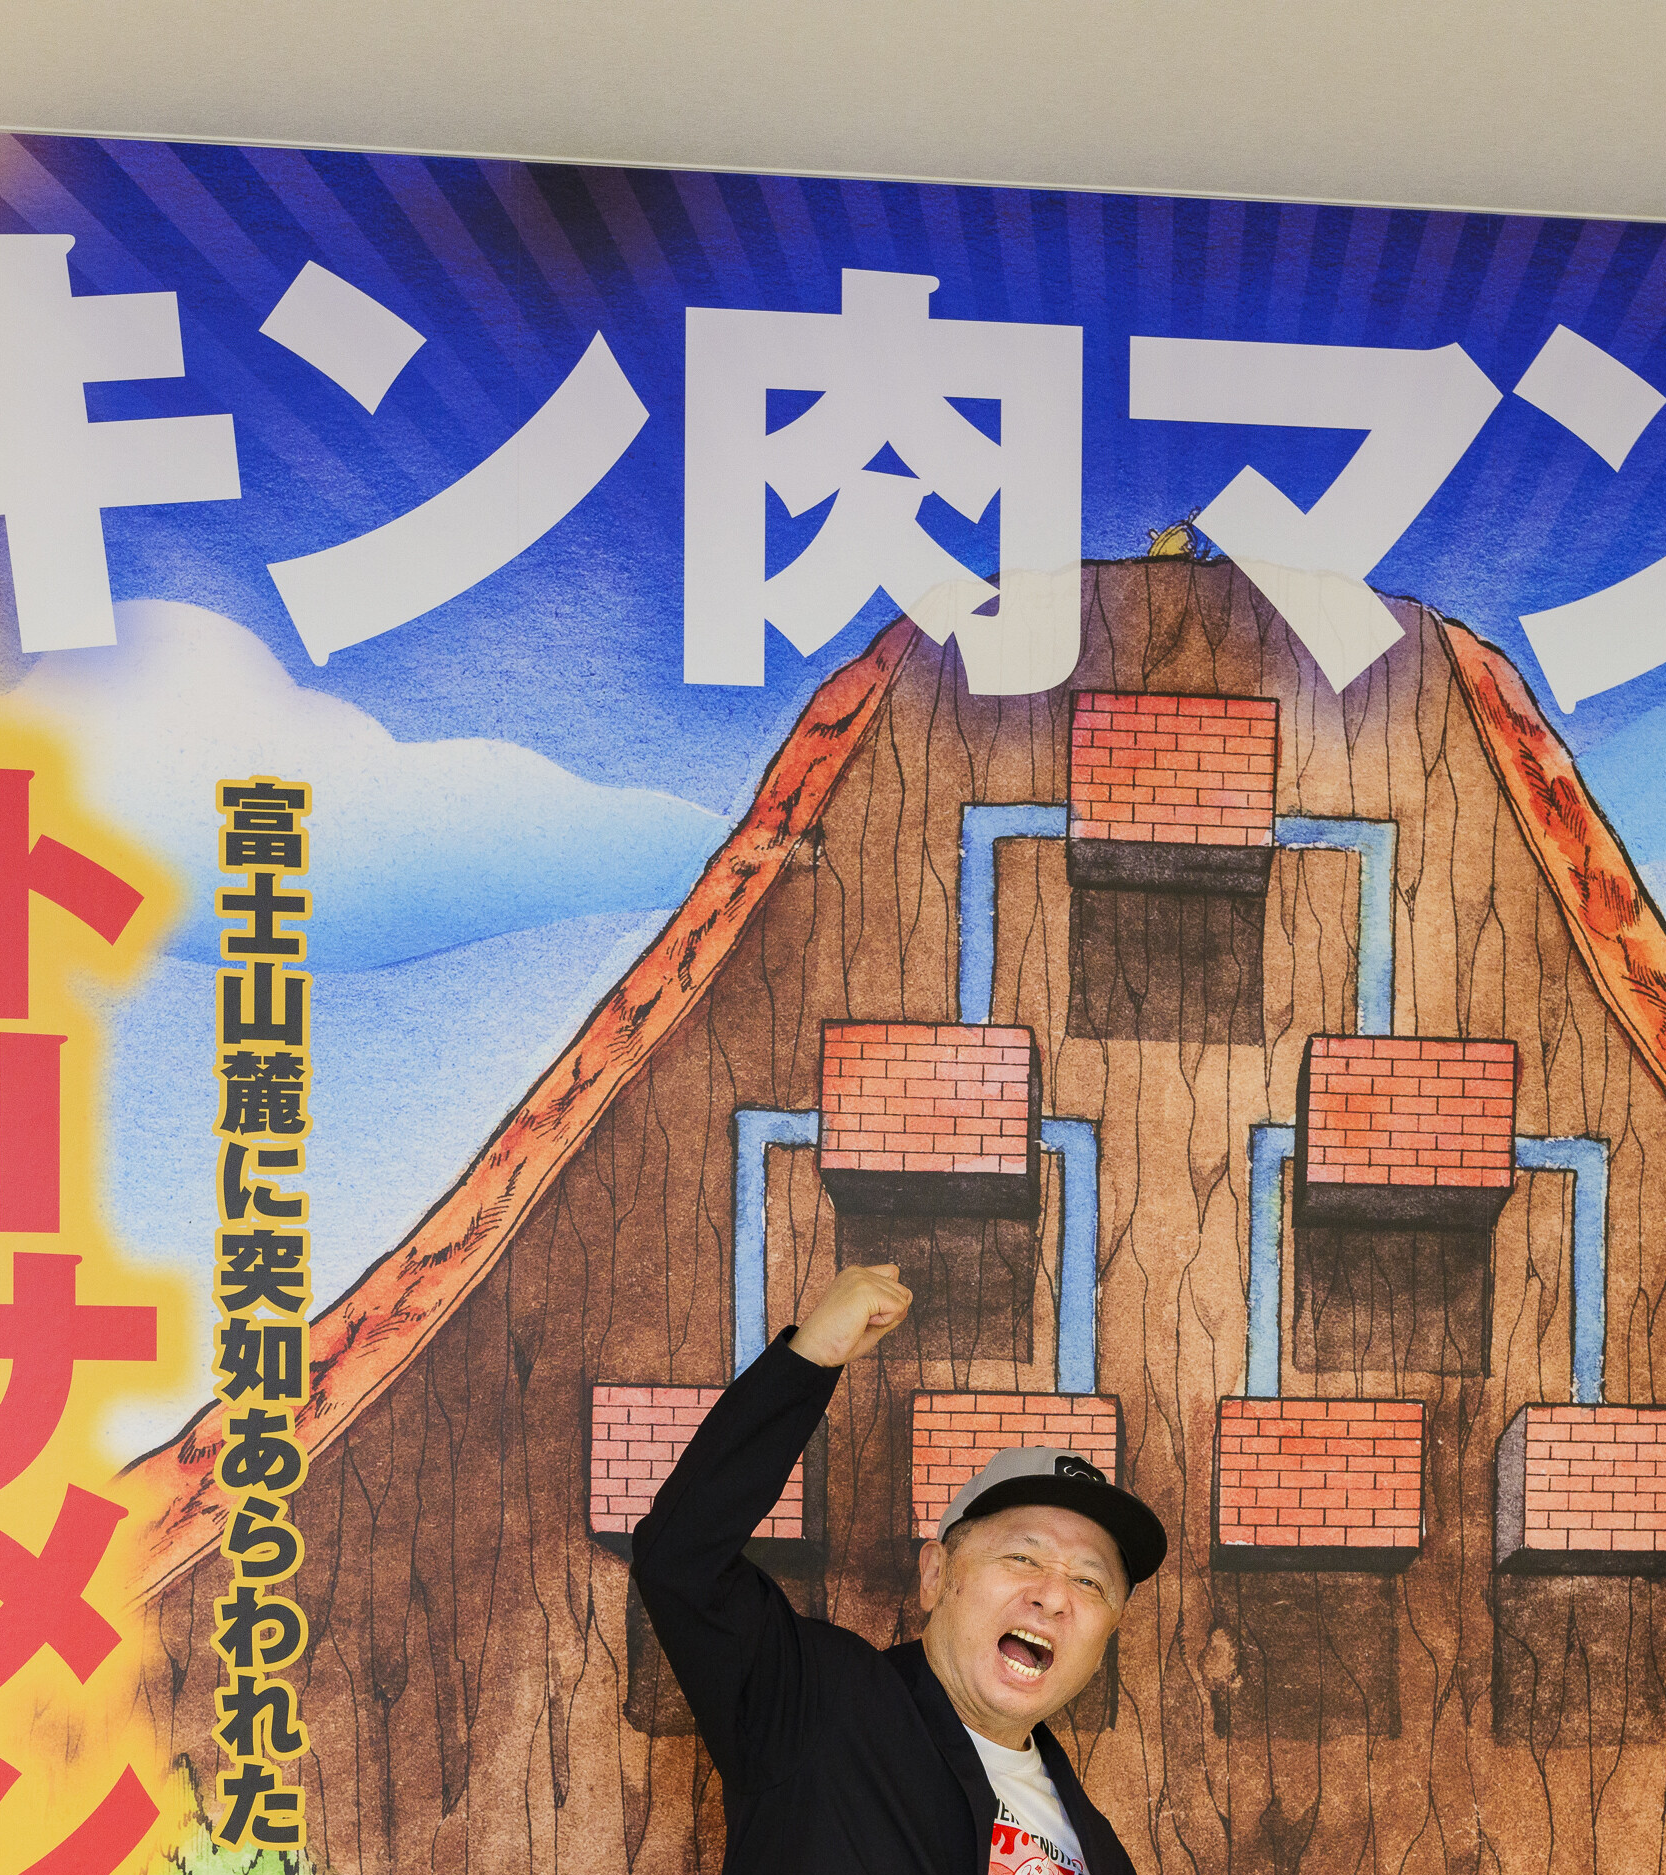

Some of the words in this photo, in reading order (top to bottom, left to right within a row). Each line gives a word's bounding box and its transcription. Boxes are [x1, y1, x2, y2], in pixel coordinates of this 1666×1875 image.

[216, 780, 307, 1848] 富士山麓に突如あらわれた
